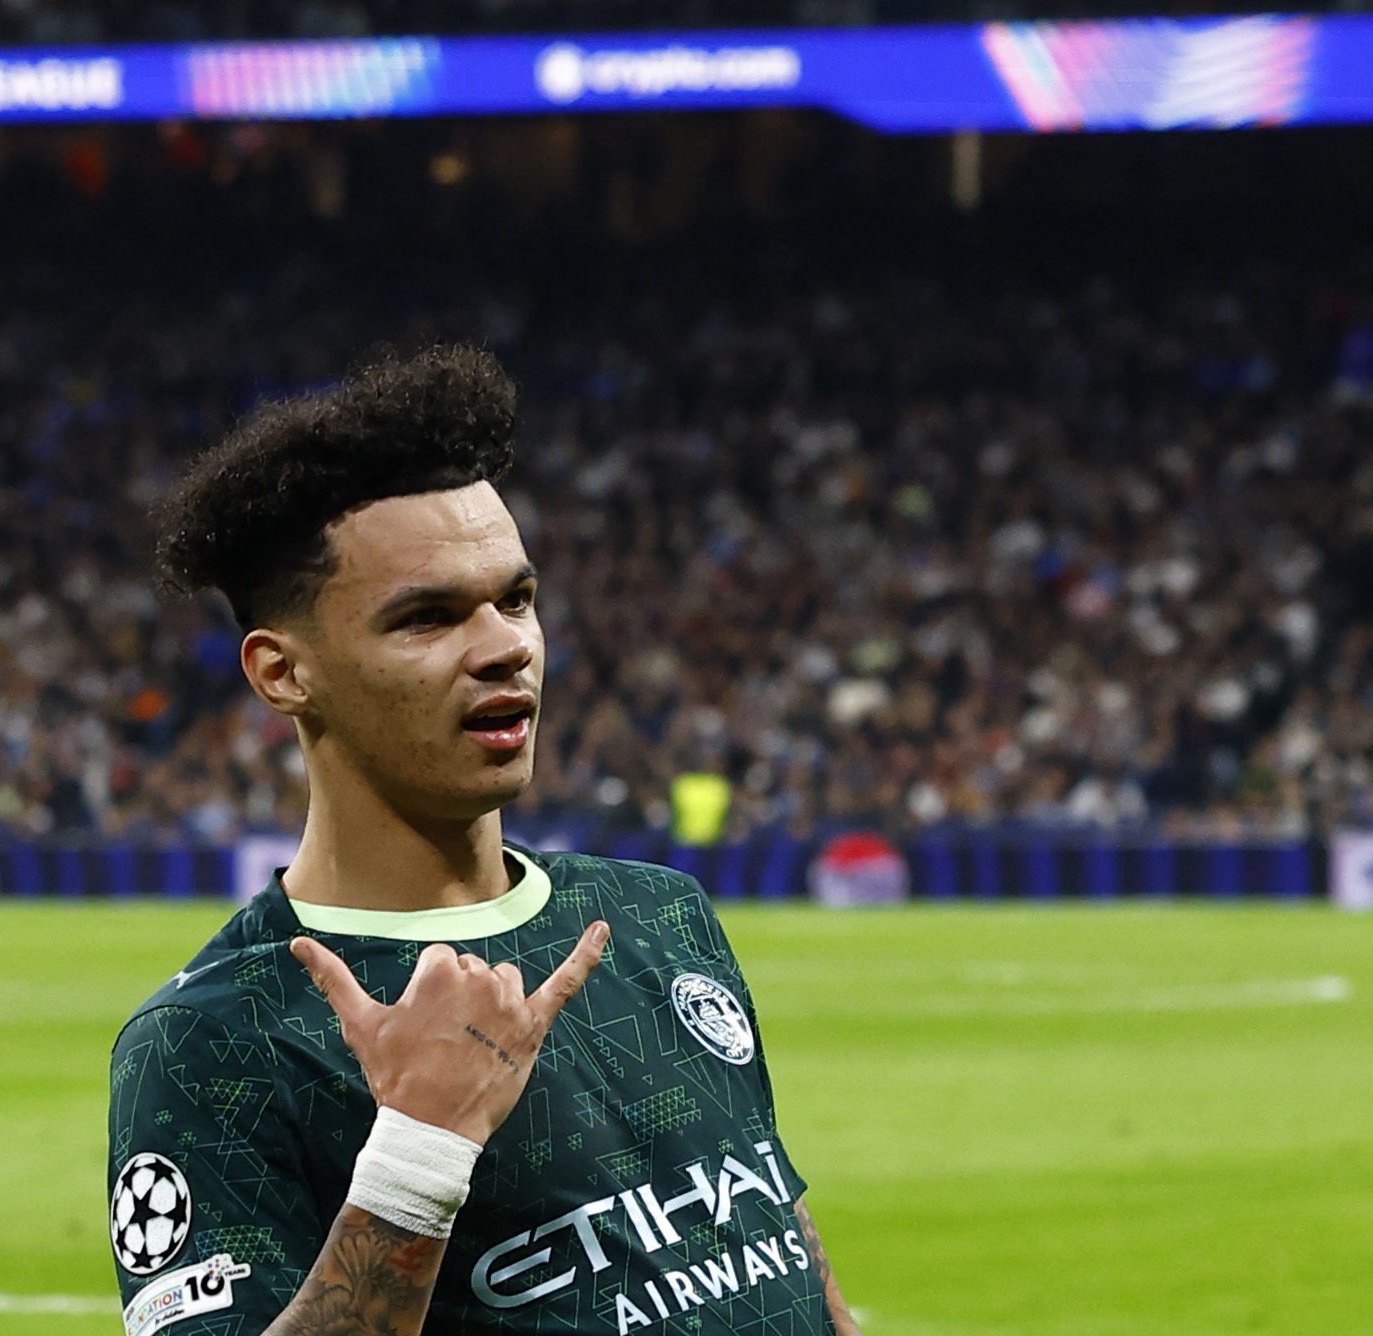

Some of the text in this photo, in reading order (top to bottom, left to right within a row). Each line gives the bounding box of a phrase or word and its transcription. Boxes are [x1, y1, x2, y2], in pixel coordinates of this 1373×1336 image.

[184, 1268, 246, 1301] 10 YEARS
[615, 1229, 810, 1336] AIRWAYS
